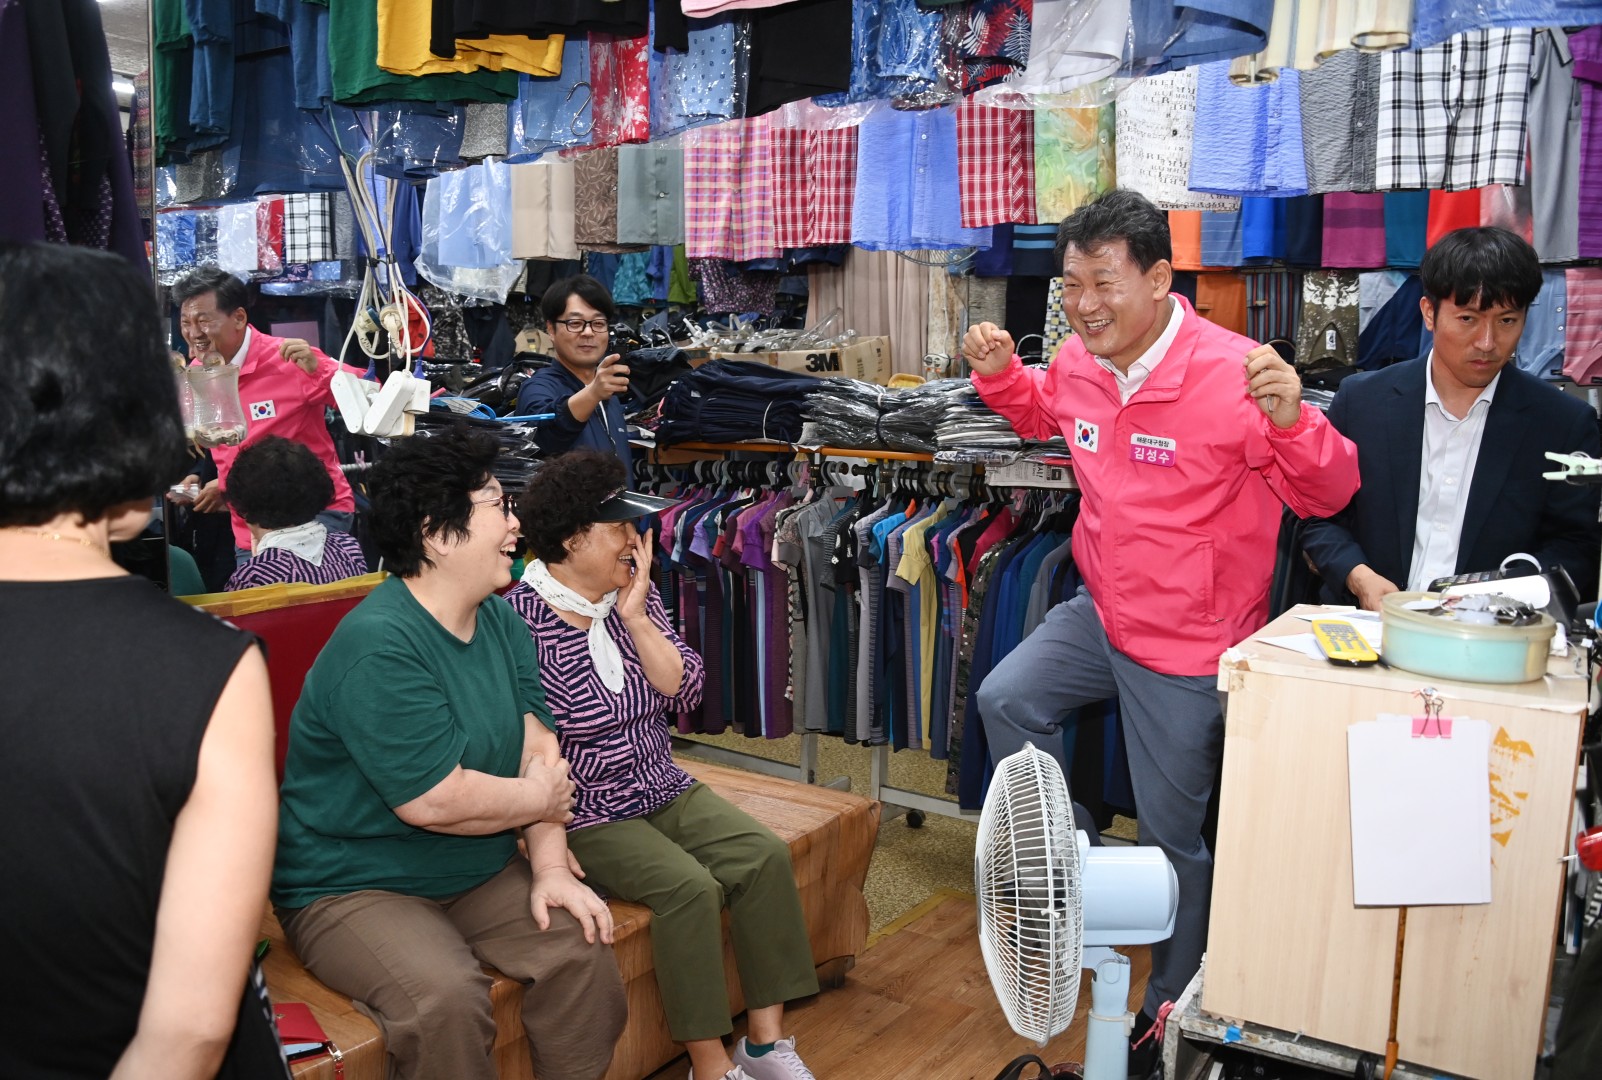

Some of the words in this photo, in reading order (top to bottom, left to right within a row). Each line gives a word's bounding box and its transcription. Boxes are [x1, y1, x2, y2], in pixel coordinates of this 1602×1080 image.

[805, 352, 840, 373] 3M
[1136, 436, 1170, 448] 해운대구청장
[1134, 447, 1170, 464] 김성수
